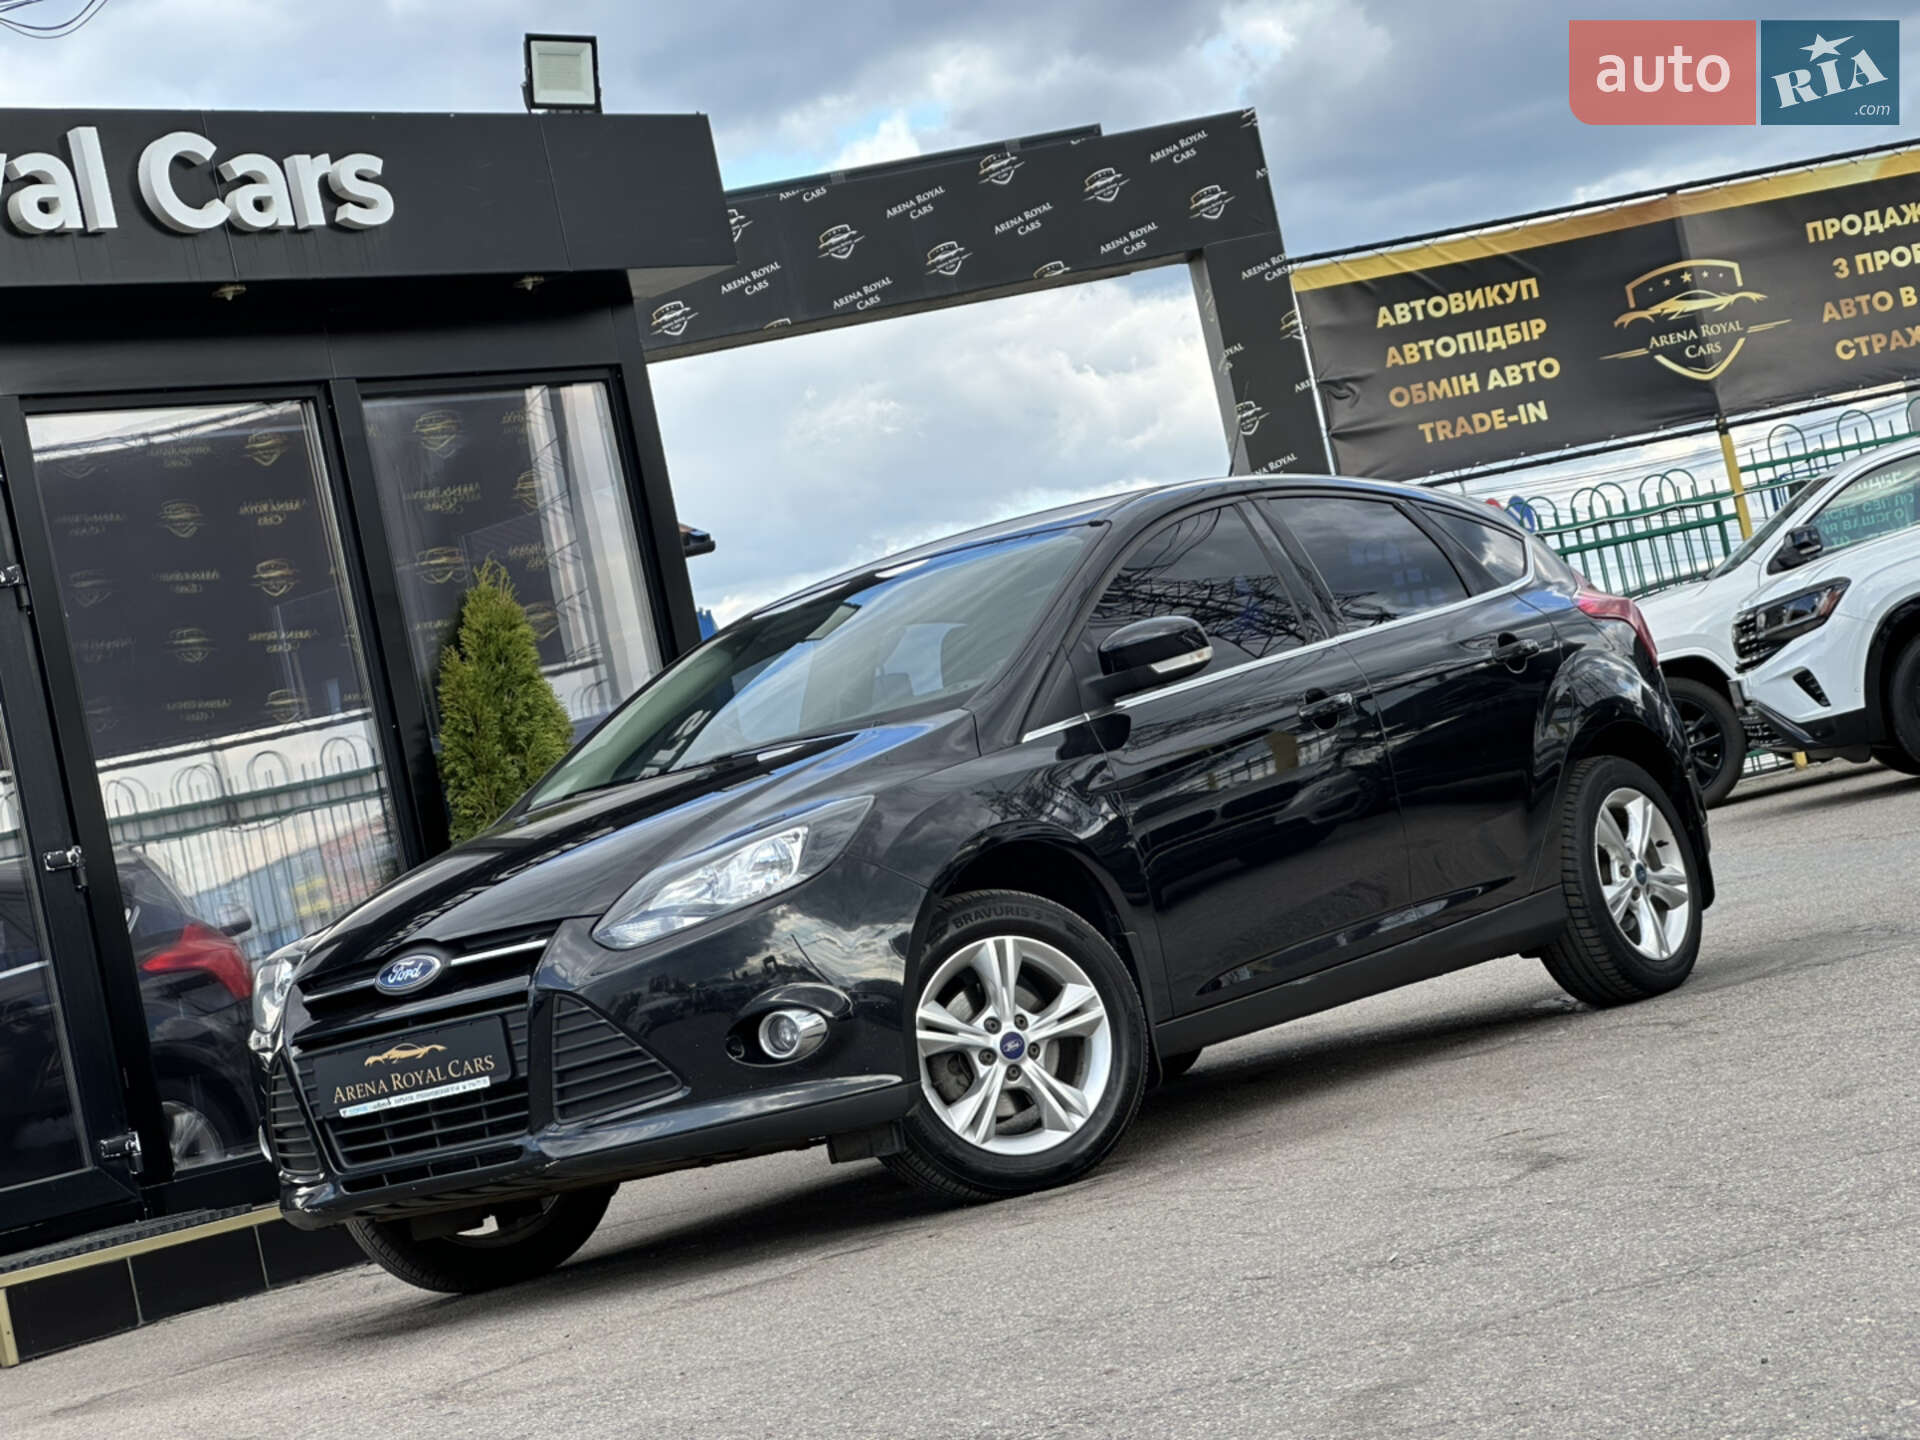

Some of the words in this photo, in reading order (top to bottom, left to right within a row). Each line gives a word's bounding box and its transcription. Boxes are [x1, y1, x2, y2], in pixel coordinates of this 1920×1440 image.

[1150, 144, 1180, 163] ARENA
[1180, 129, 1208, 149] ROYAL
[1172, 147, 1198, 165] CARS
[0, 126, 118, 233] al
[137, 131, 395, 234] Cars
[885, 198, 915, 219] ARENA
[915, 185, 946, 205] ROYAL
[909, 203, 935, 220] CARS
[993, 217, 1023, 235] ARENA
[1023, 202, 1053, 221] ROYAL
[1017, 219, 1042, 236] CARS
[1100, 236, 1129, 255] ARENA
[1129, 221, 1159, 241] ROYAL
[1123, 239, 1148, 256] CARS
[720, 276, 751, 295] ARENA
[750, 261, 782, 281] ROYAL
[744, 278, 770, 296] CARS
[1240, 261, 1271, 280] ARENA
[832, 291, 863, 310] ARENA
[862, 276, 893, 296] ROYAL
[856, 294, 881, 312] CARS
[1376, 277, 1540, 329] АВТОВИКУП
[1821, 291, 1895, 324] АВТО
[1899, 286, 1919, 308] В
[1385, 318, 1548, 369] АВТОПІДБІР
[1649, 328, 1698, 350] ARENA
[1699, 320, 1744, 338] ROYAL
[1684, 341, 1722, 359] CARS
[1388, 372, 1480, 408] ОБМІН
[1487, 356, 1561, 391] АВТО
[1418, 400, 1549, 444] TRADE-IN
[951, 905, 1030, 929] BRAVURIS
[387, 961, 422, 984] Ford
[333, 1078, 390, 1104] ARENA
[390, 1065, 448, 1091] ROYAL
[447, 1055, 496, 1079] CARS
